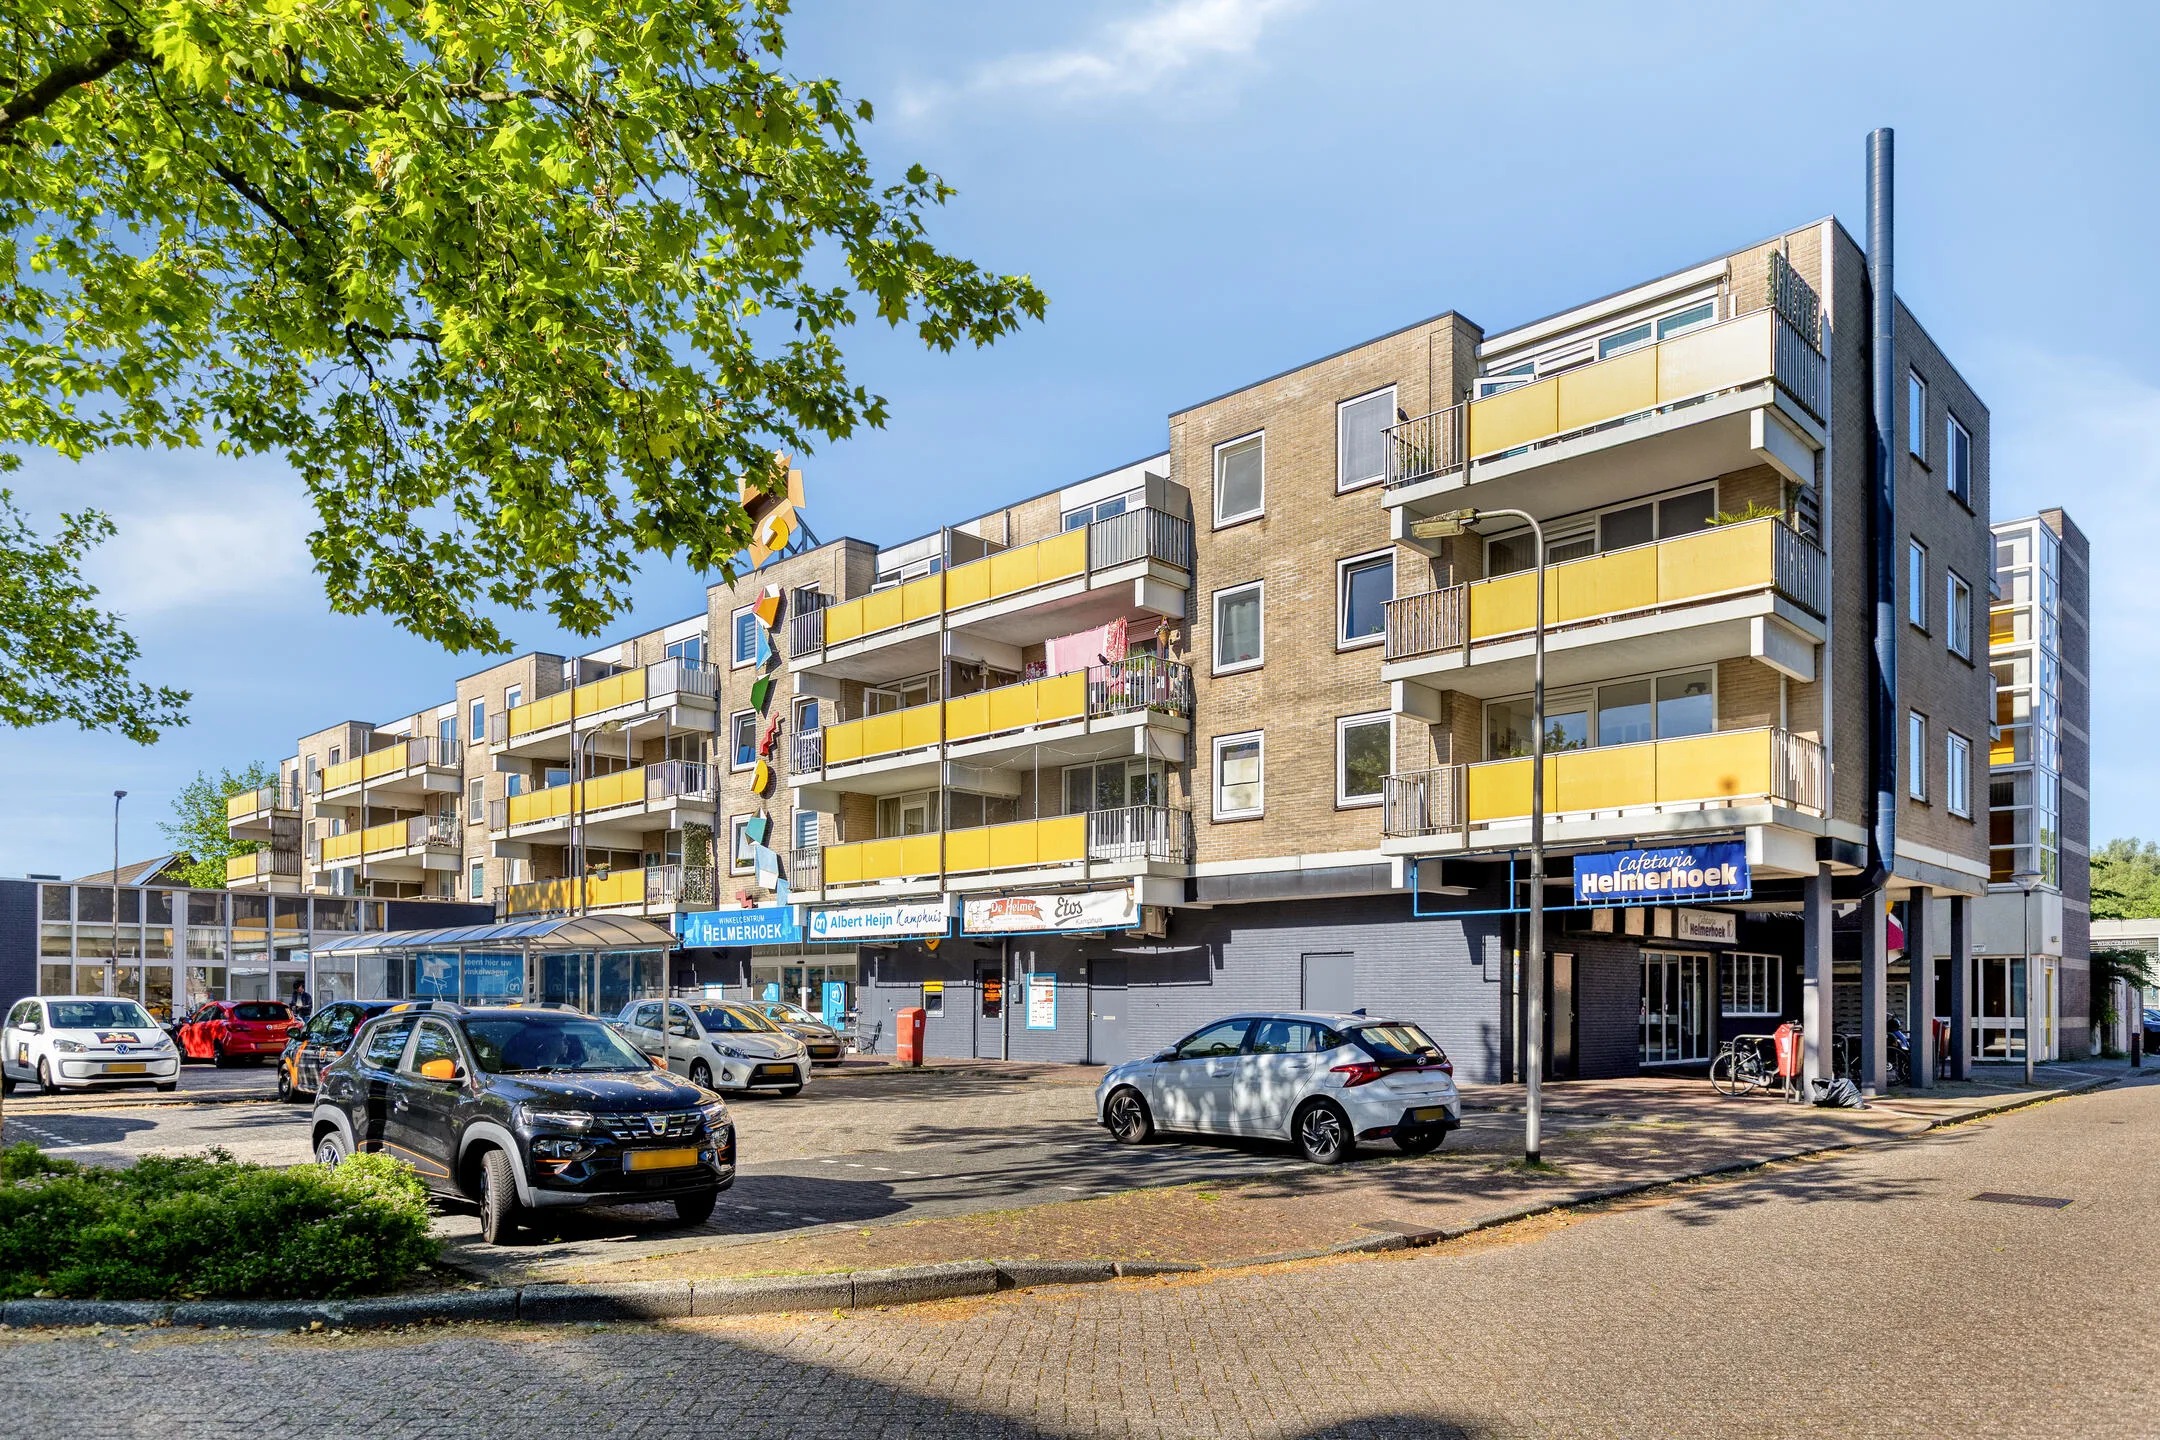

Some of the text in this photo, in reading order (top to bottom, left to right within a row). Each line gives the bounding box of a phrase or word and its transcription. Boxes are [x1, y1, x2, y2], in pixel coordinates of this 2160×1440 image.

[1618, 851, 1696, 878] Cafetaria
[1582, 863, 1738, 894] Helmerhoek
[992, 897, 1036, 915] De Helmer
[1054, 896, 1083, 918] Etos
[719, 914, 765, 925] WINKELCENTRUM
[830, 908, 942, 929] Albert Heijn Kamphuis
[703, 923, 782, 942] HELMERHOEK
[1689, 922, 1726, 938] Helmerhoek
